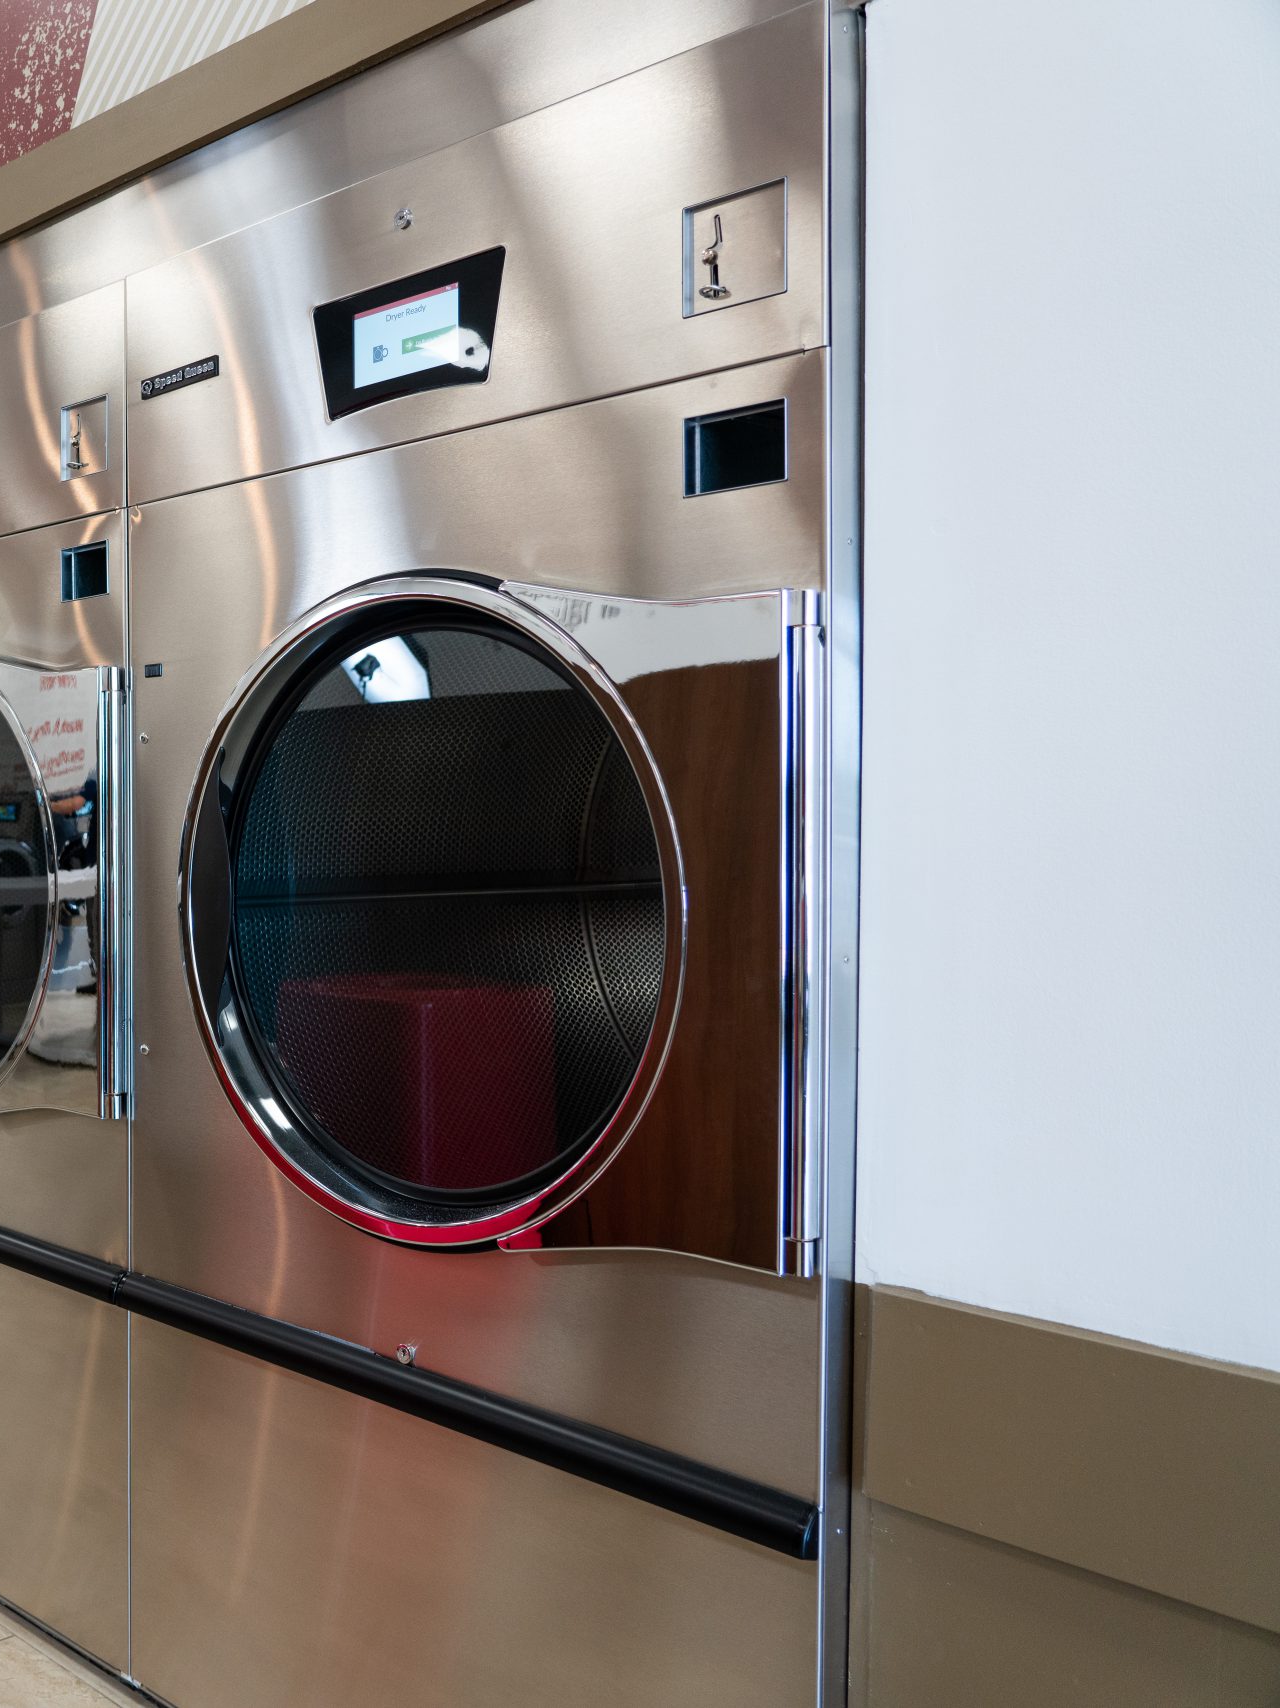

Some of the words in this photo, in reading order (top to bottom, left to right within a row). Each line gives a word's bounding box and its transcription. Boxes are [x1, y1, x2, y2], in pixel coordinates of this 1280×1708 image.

[385, 311, 404, 322] Dryer
[406, 303, 427, 315] Ready
[154, 370, 183, 389] Speed
[184, 361, 215, 378] Queen
